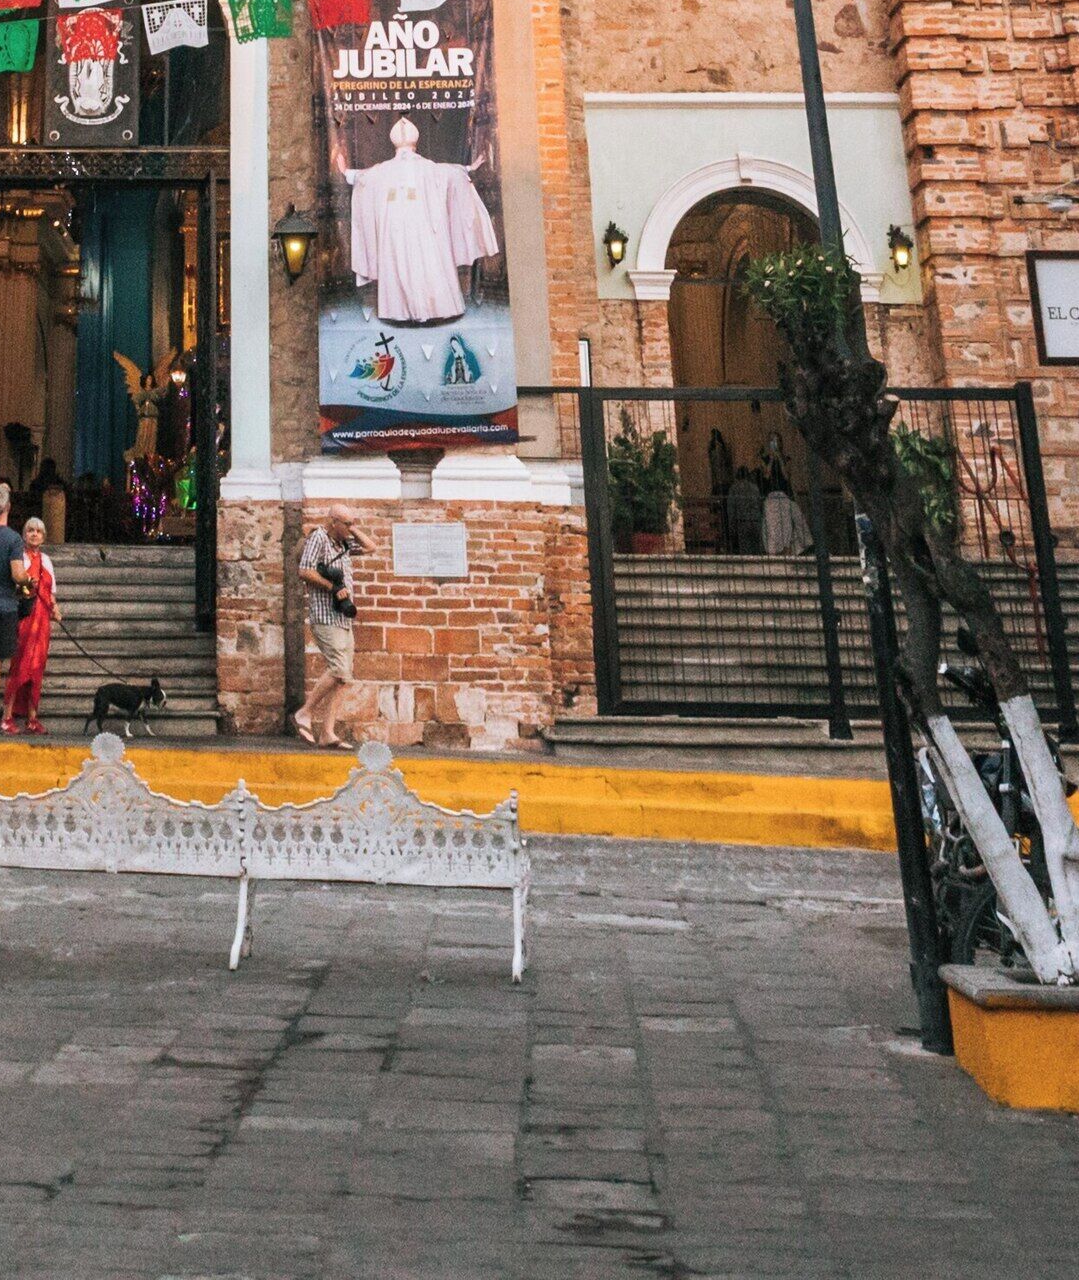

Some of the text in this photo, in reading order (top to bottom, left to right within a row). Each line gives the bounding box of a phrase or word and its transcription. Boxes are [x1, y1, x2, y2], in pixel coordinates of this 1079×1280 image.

[365, 14, 440, 50] AÑO
[333, 48, 474, 79] JUBILAR
[333, 79, 475, 91] PEREGRINO DE LA ESPERANZA
[334, 89, 476, 101] JUBILEO 2025
[344, 102, 354, 111] DE
[355, 102, 391, 111] DICIEMBRE
[393, 101, 412, 111] 2024
[423, 101, 432, 110] DE
[433, 101, 457, 110] ENERO
[1047, 306, 1067, 320] EL
[332, 424, 509, 439] www.parroquiadeguadalupevallarta.com
